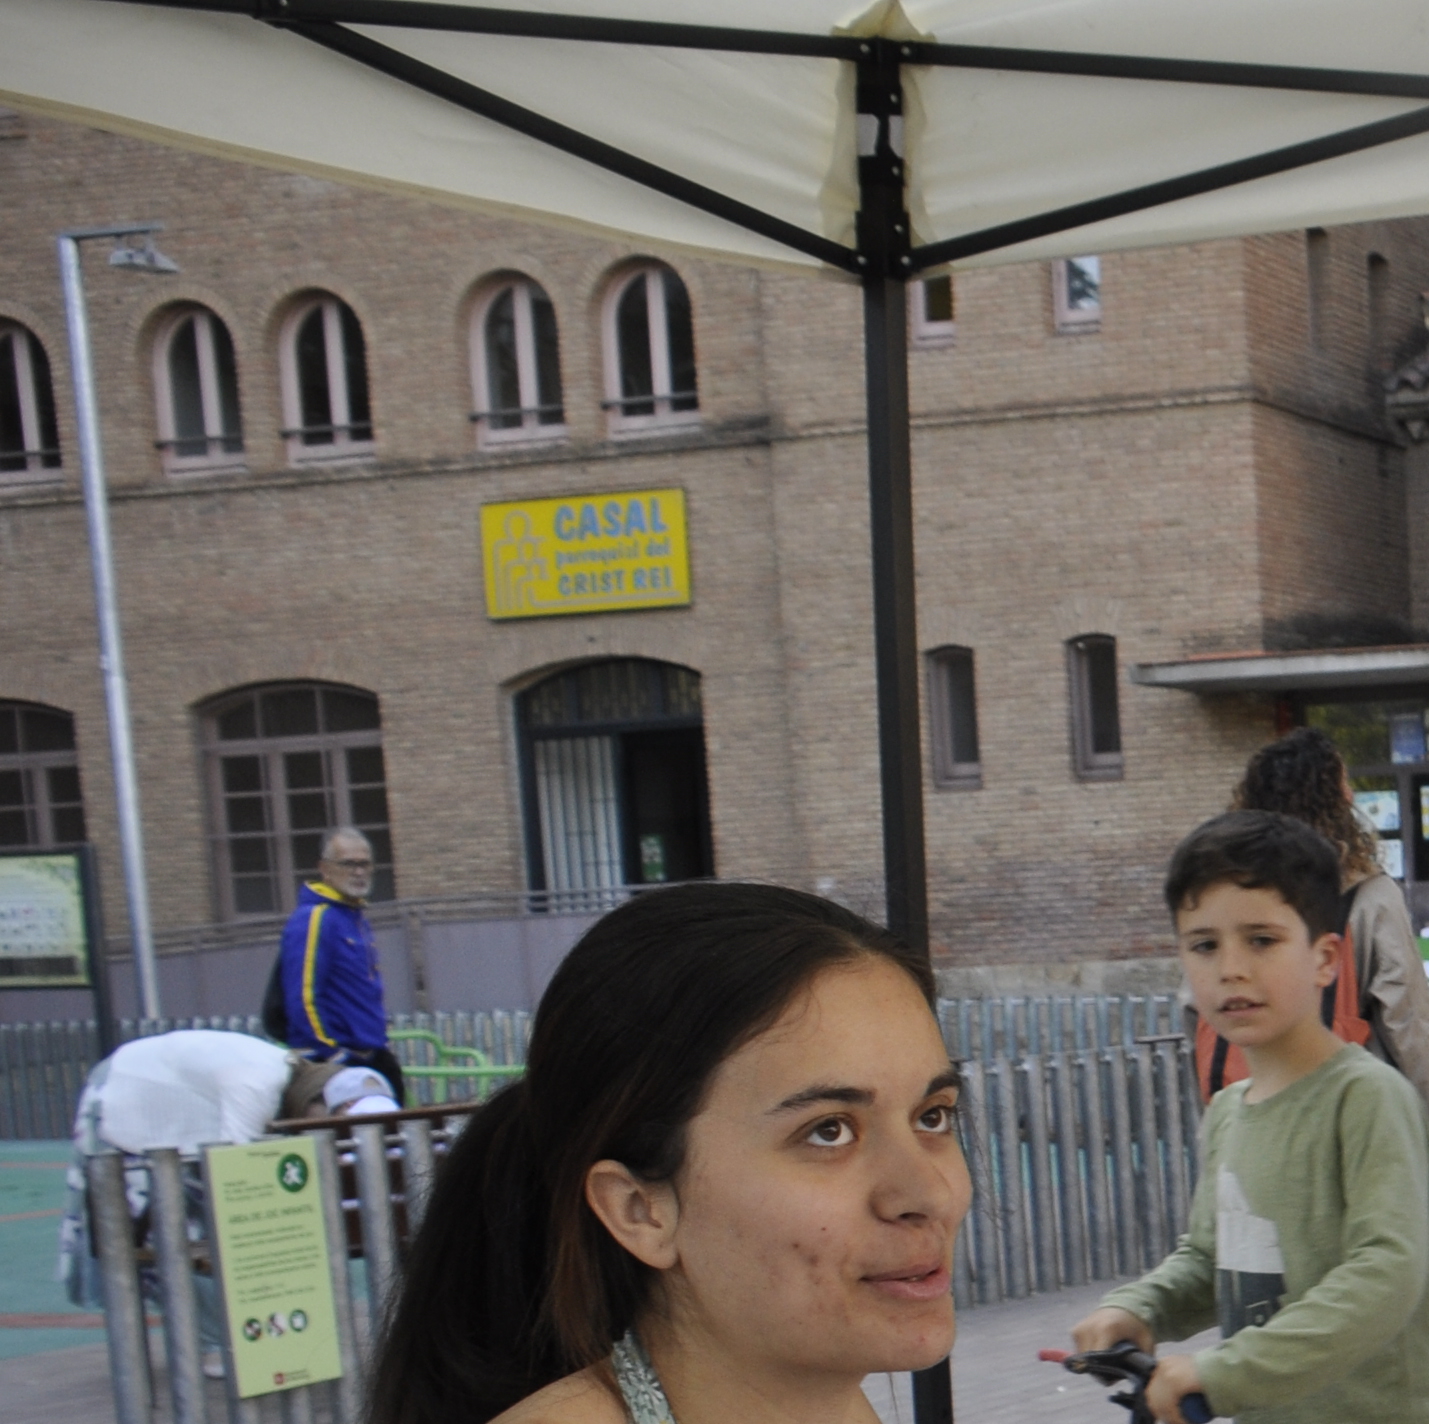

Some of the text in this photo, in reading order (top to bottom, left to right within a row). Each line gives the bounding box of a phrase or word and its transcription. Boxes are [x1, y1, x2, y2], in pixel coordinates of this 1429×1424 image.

[554, 499, 668, 541] CASAL
[557, 566, 672, 596] CRIST REI
